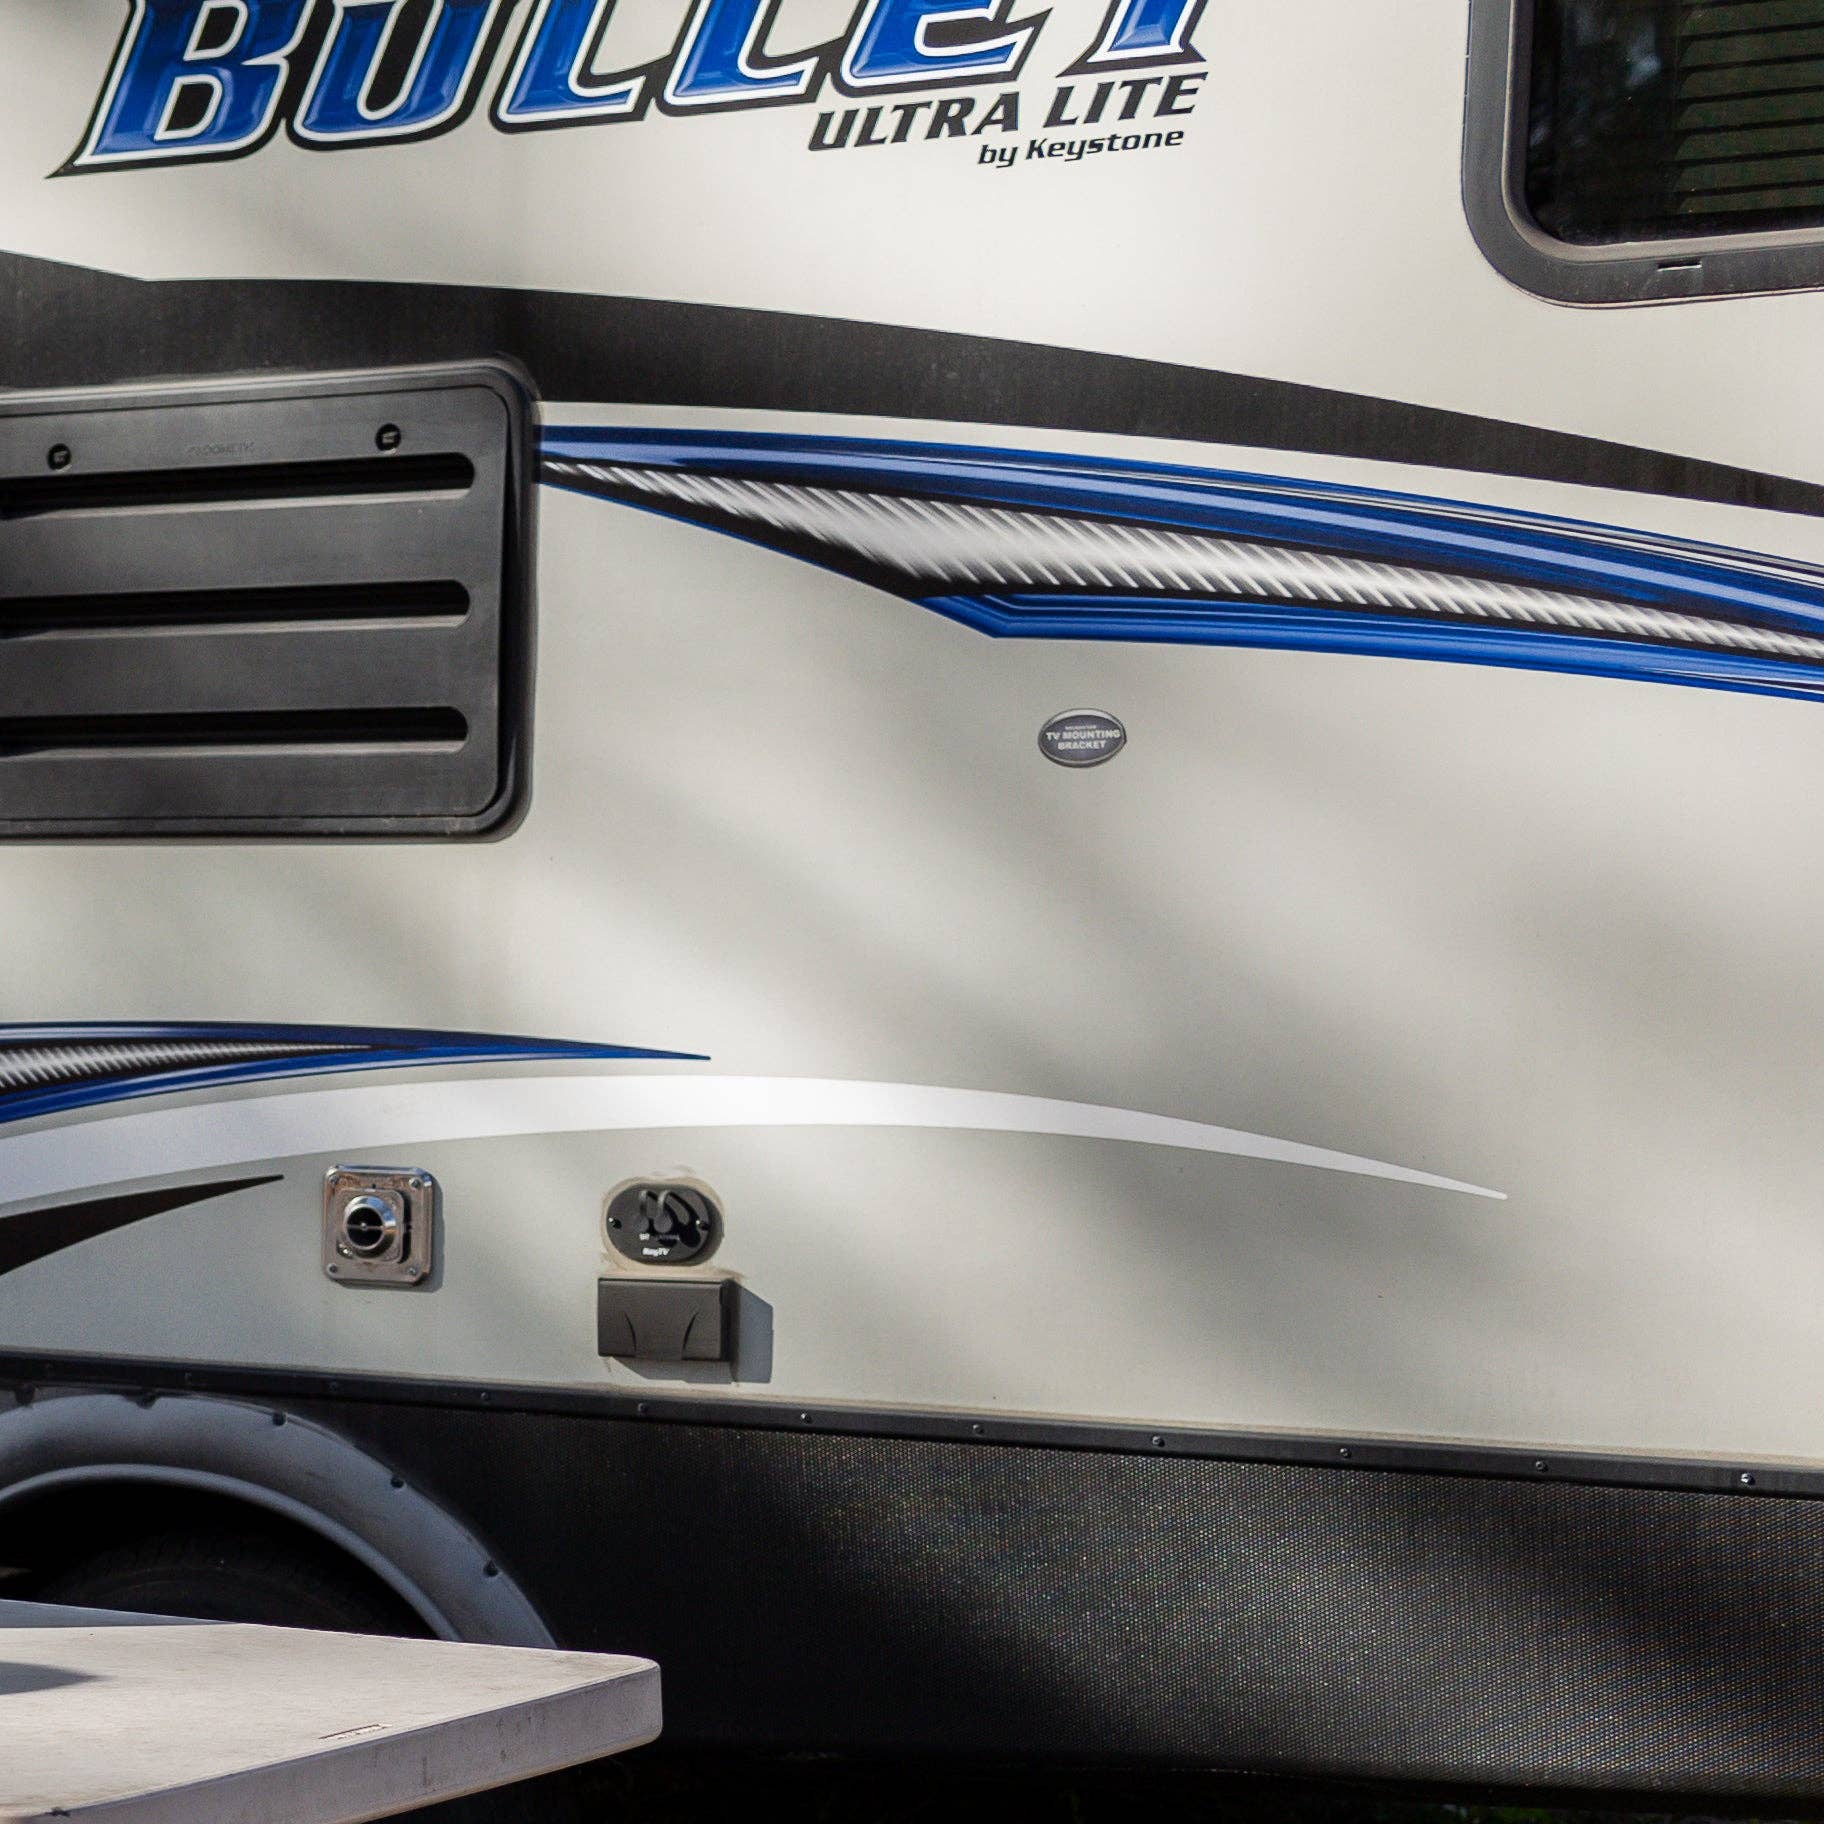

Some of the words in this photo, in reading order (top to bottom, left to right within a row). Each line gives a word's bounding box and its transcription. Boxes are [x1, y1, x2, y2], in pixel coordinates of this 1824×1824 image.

[808, 91, 1020, 151] ULTRA
[1042, 71, 1209, 129] LITE
[977, 143, 1019, 168] by
[1025, 130, 1184, 162] Keystone
[1046, 731, 1061, 741] TV
[1062, 729, 1121, 741] MOUNTING
[1057, 740, 1107, 750] BRACKET
